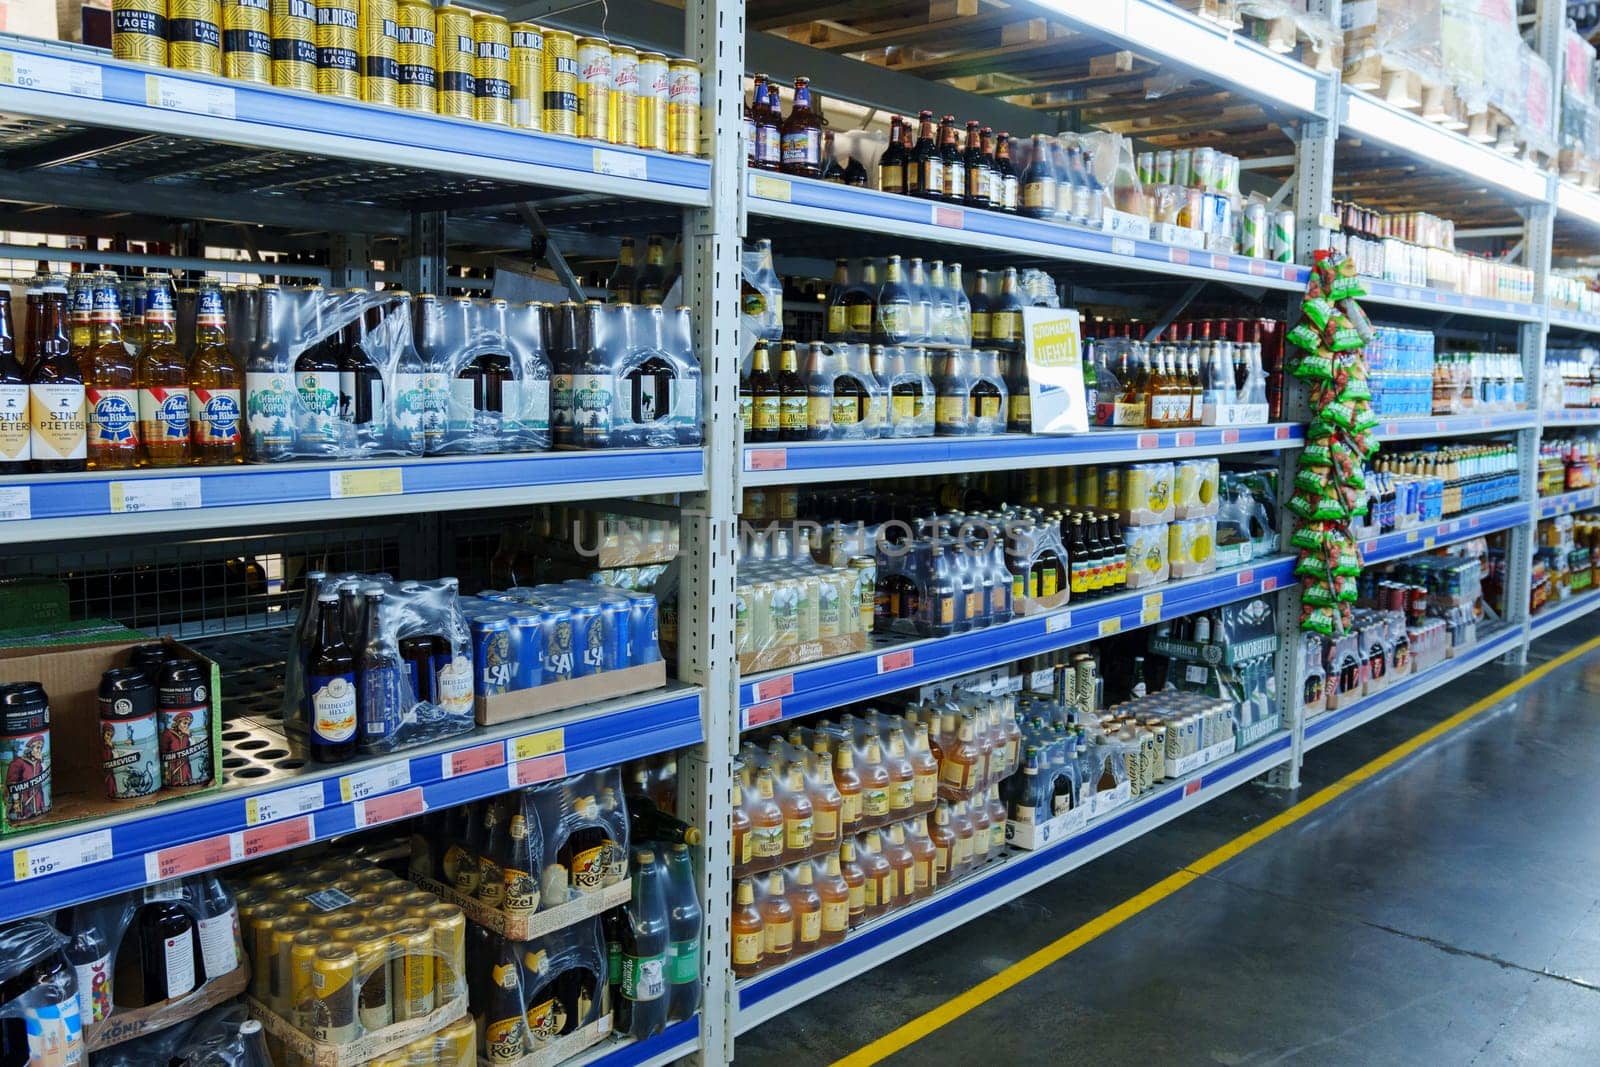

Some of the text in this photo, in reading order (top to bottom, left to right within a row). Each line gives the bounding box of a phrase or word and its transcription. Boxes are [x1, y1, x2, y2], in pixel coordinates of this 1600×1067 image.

[117, 18, 156, 30] LAGER
[323, 54, 356, 66] LAGER
[102, 400, 126, 412] Pabst
[211, 399, 233, 411] Pabst
[50, 411, 78, 420] SINT
[110, 412, 136, 422] Ribbon
[32, 863, 54, 875] 199
